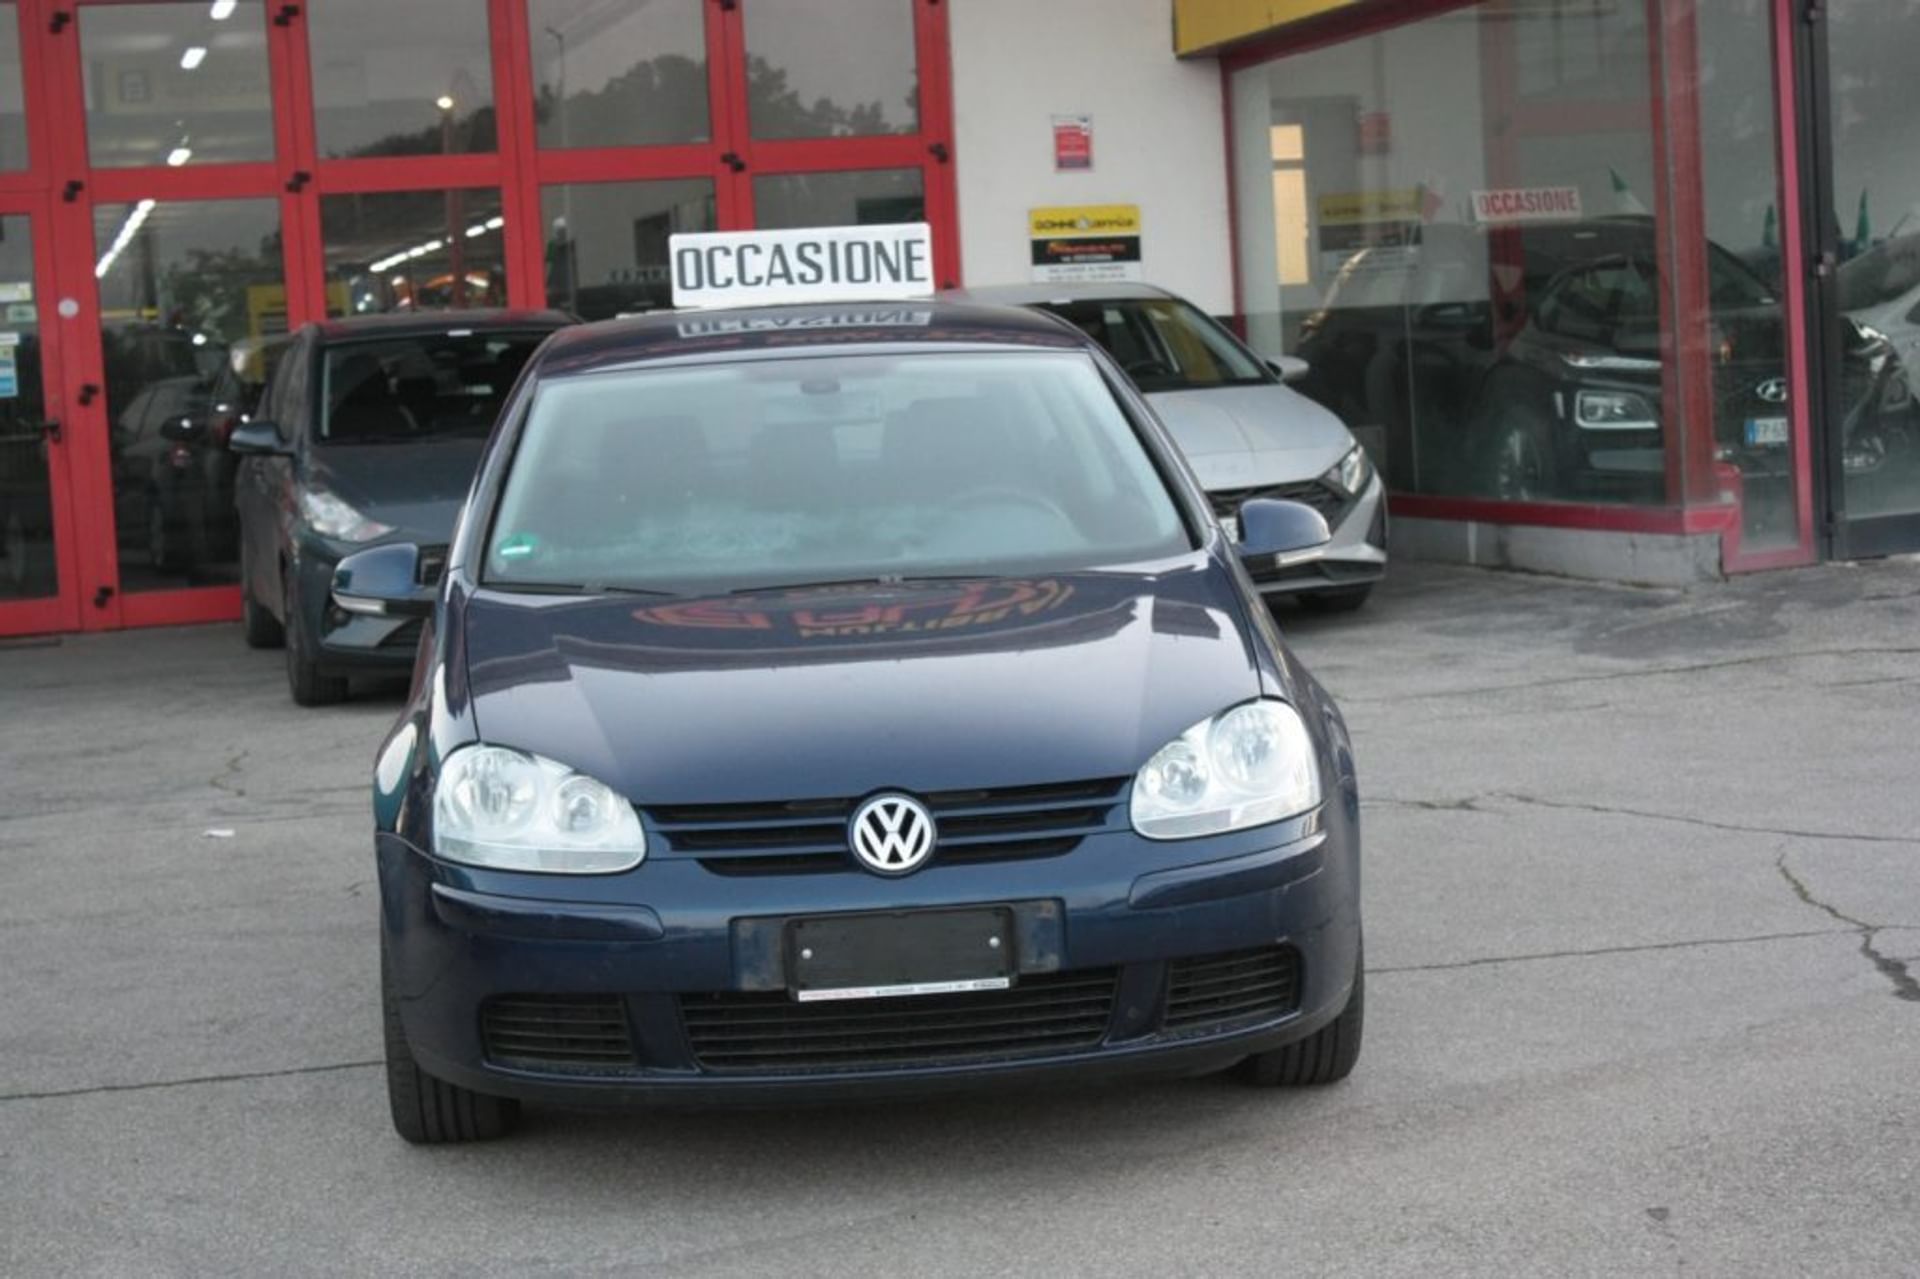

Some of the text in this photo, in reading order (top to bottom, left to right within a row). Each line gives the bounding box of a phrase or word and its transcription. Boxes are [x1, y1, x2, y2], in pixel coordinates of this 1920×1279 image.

[1478, 190, 1577, 214] OCCASIONE
[676, 239, 927, 290] OCCASIONE
[855, 799, 930, 867] VW
